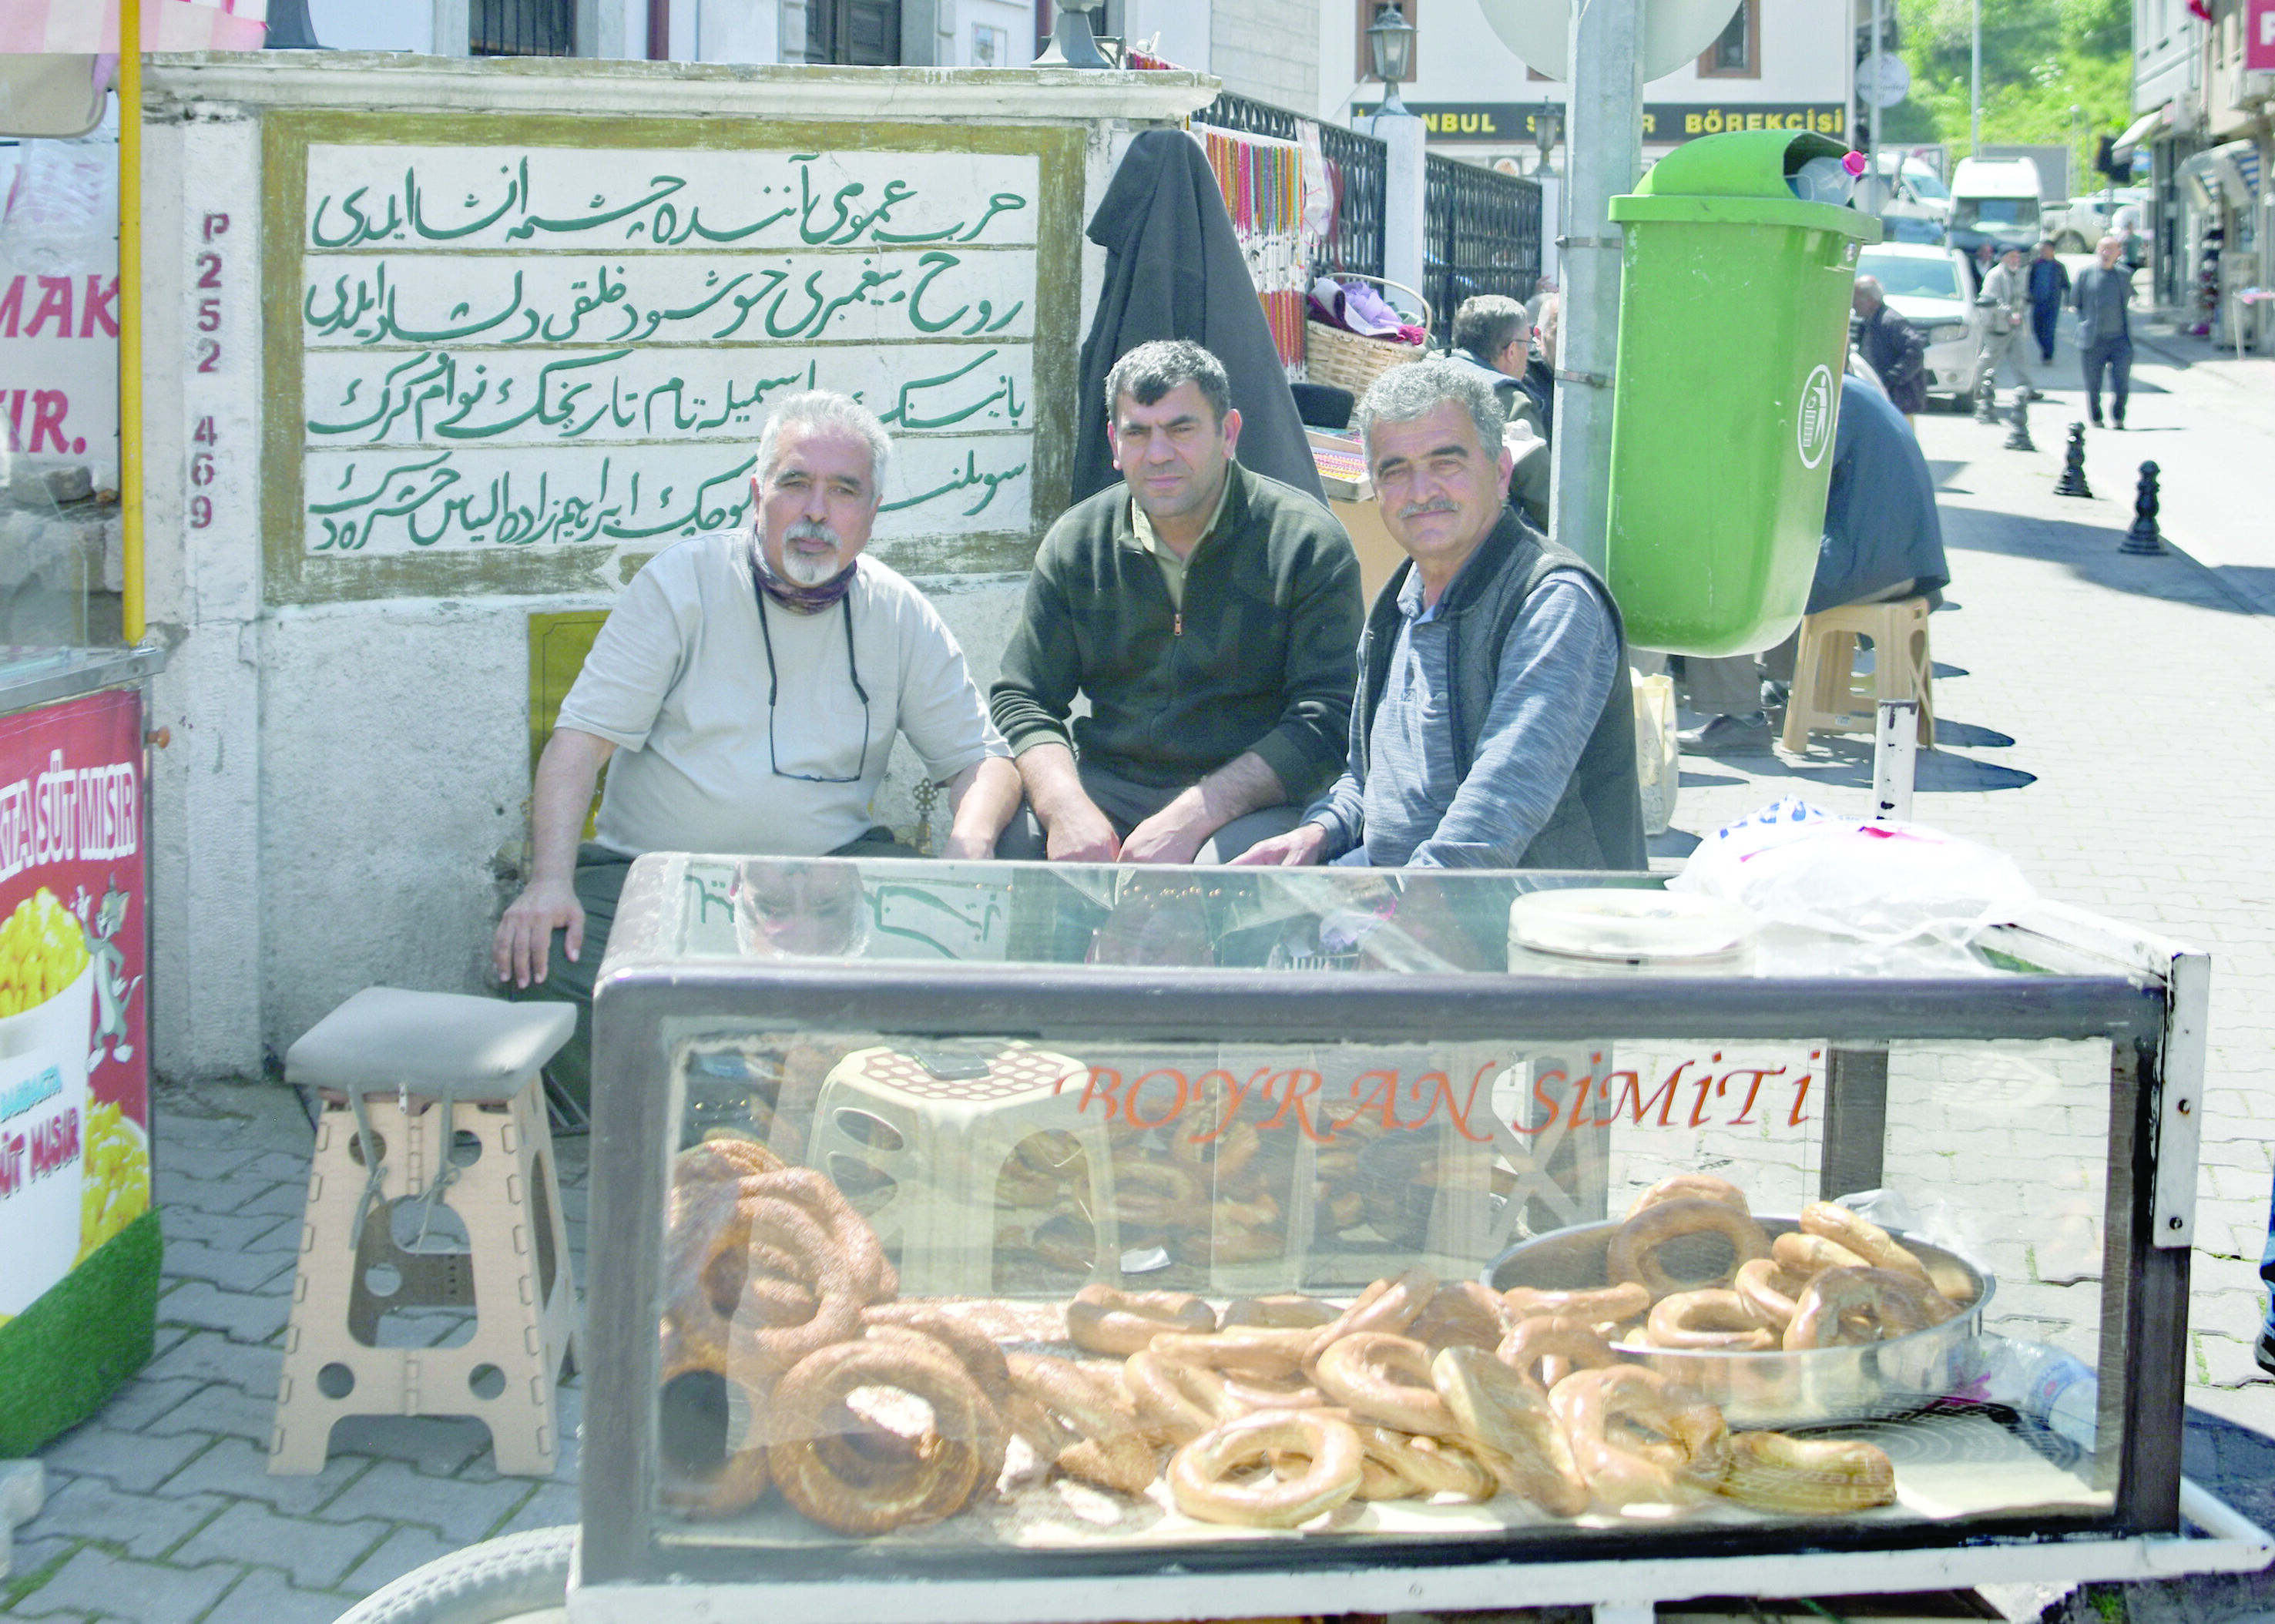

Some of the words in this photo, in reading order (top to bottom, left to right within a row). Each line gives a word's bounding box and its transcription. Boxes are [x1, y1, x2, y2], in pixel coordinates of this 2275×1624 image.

[908, 251, 1025, 336] روح
[35, 749, 77, 865] SÜT
[79, 761, 137, 861] MISIR
